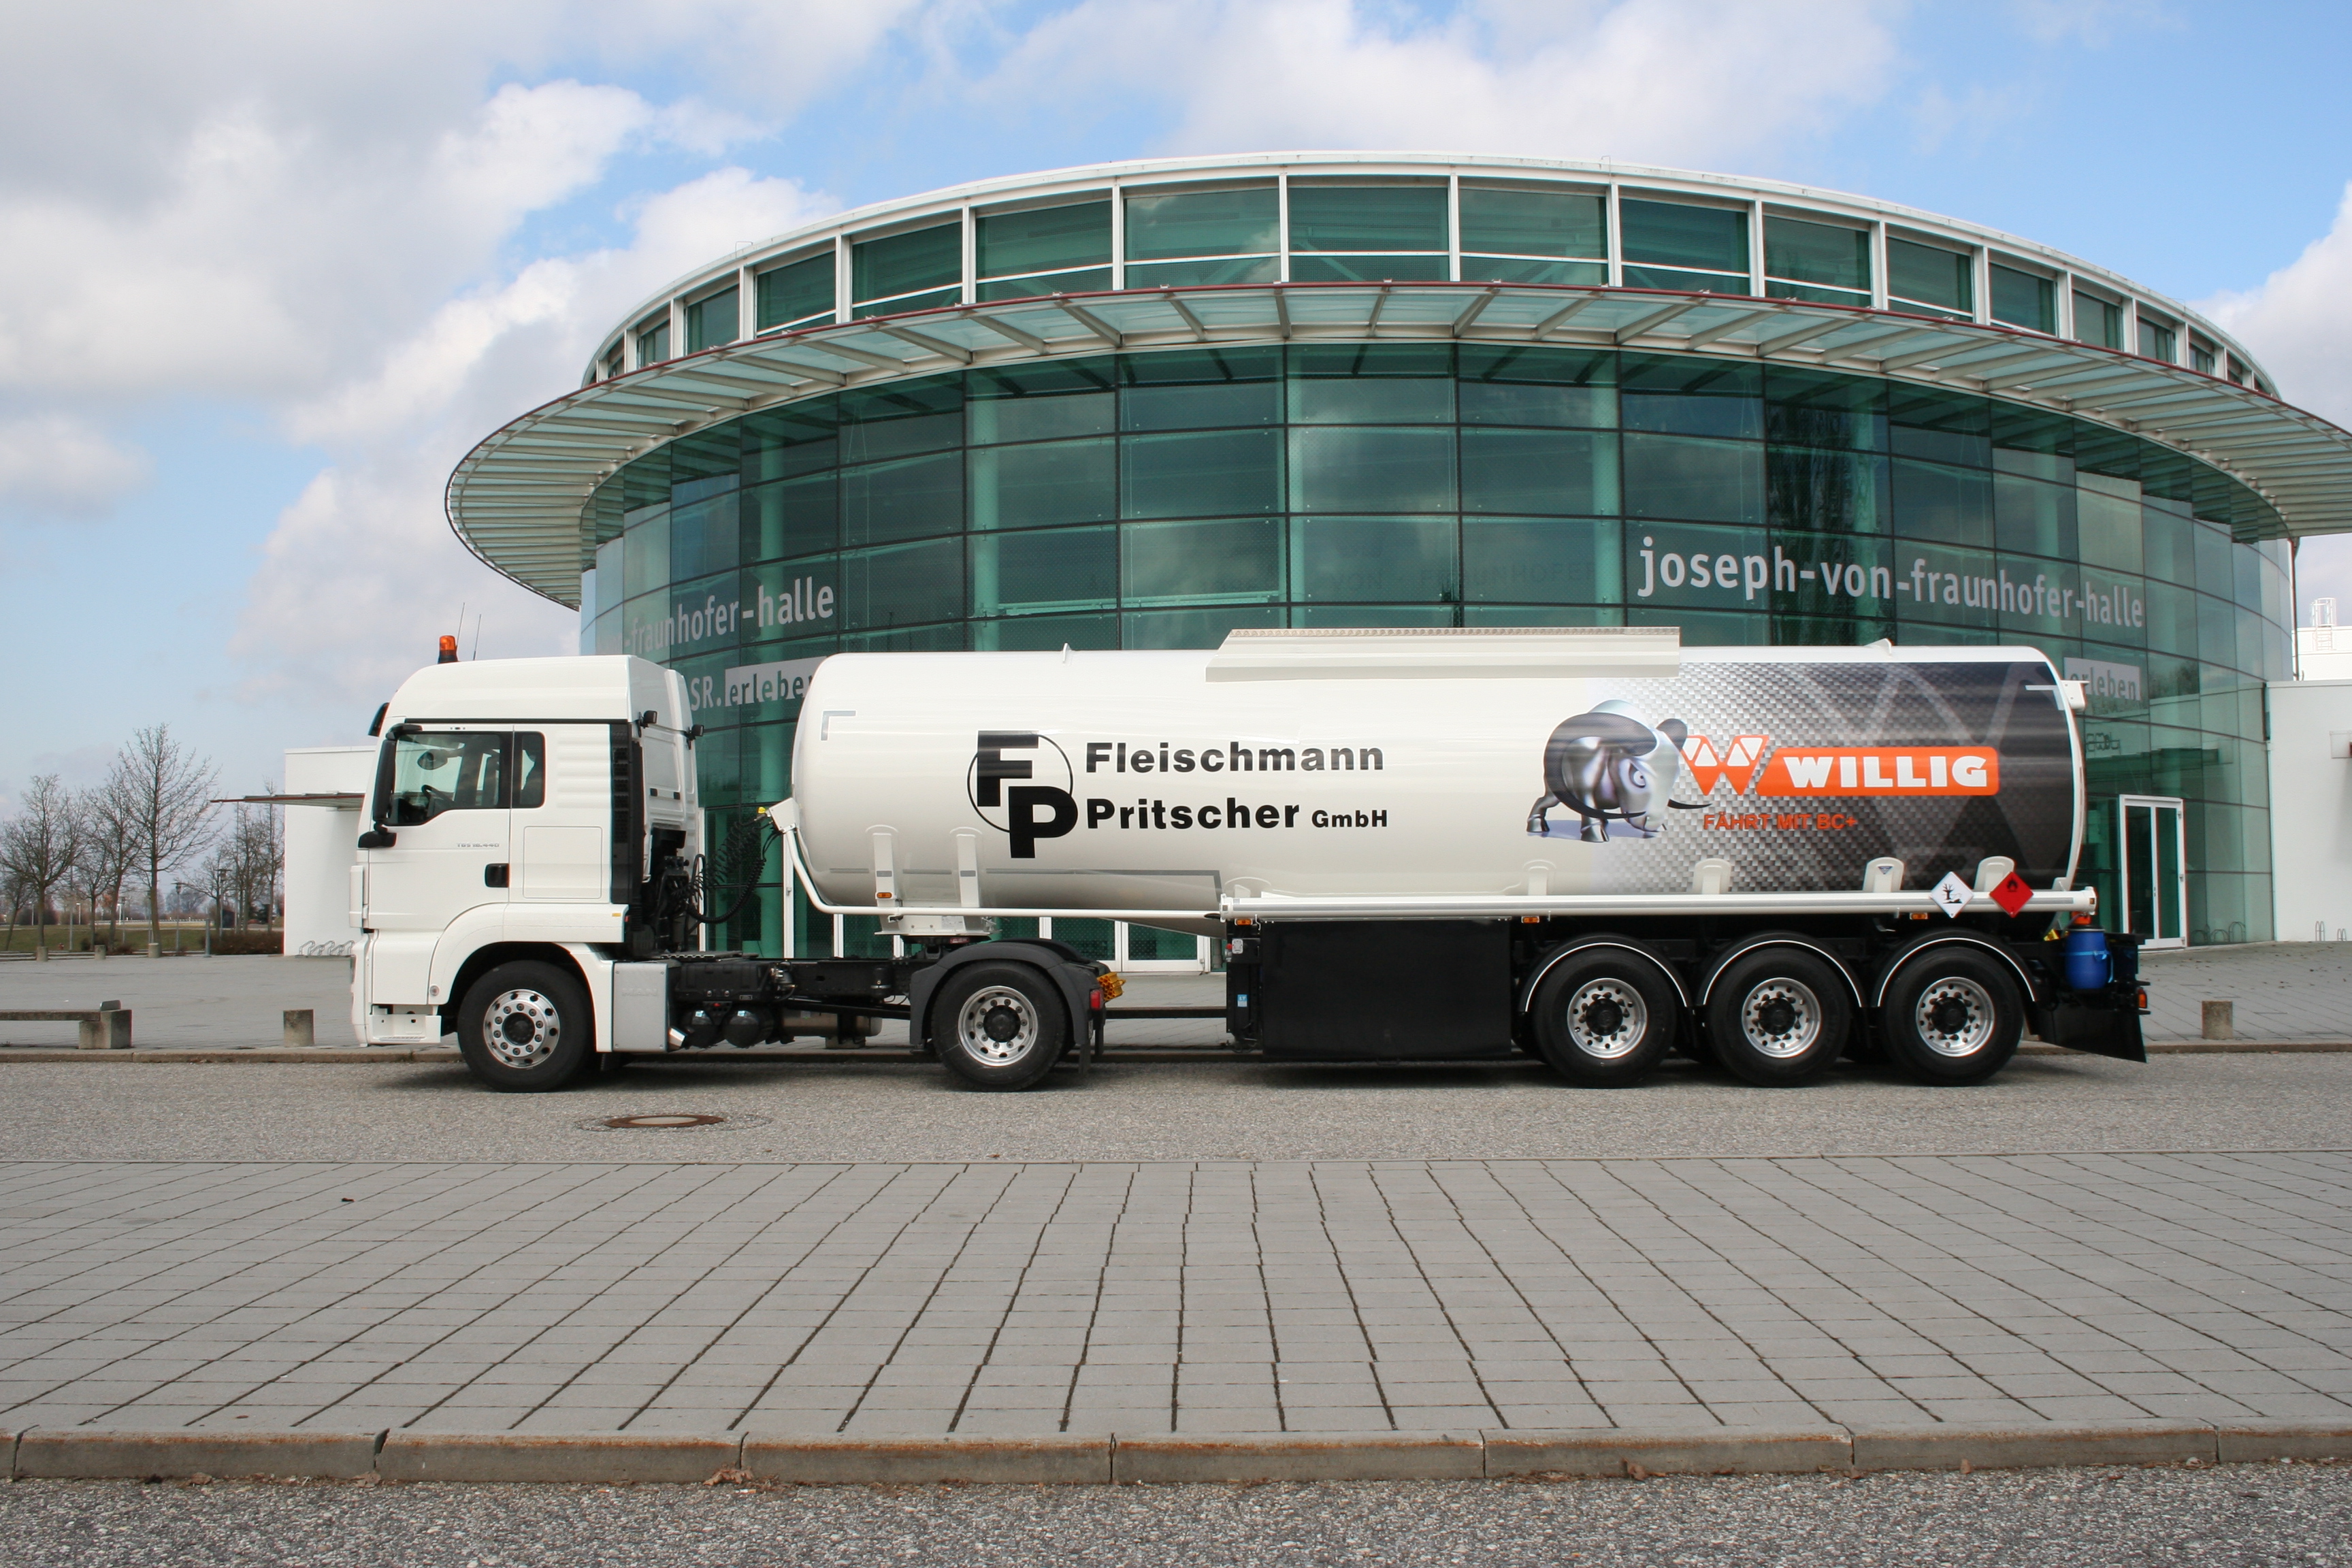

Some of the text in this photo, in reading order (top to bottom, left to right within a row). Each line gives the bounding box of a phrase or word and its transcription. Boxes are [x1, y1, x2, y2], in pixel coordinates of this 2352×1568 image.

[1637, 536, 2143, 628] joseph-von-fraunhofer-halle
[1086, 741, 1384, 773] Fleischmann
[1783, 755, 1987, 788] WILLIG
[1087, 798, 1388, 830] Pritscher GmbH
[1703, 811, 1859, 830] FÄHRT MIT BC+
